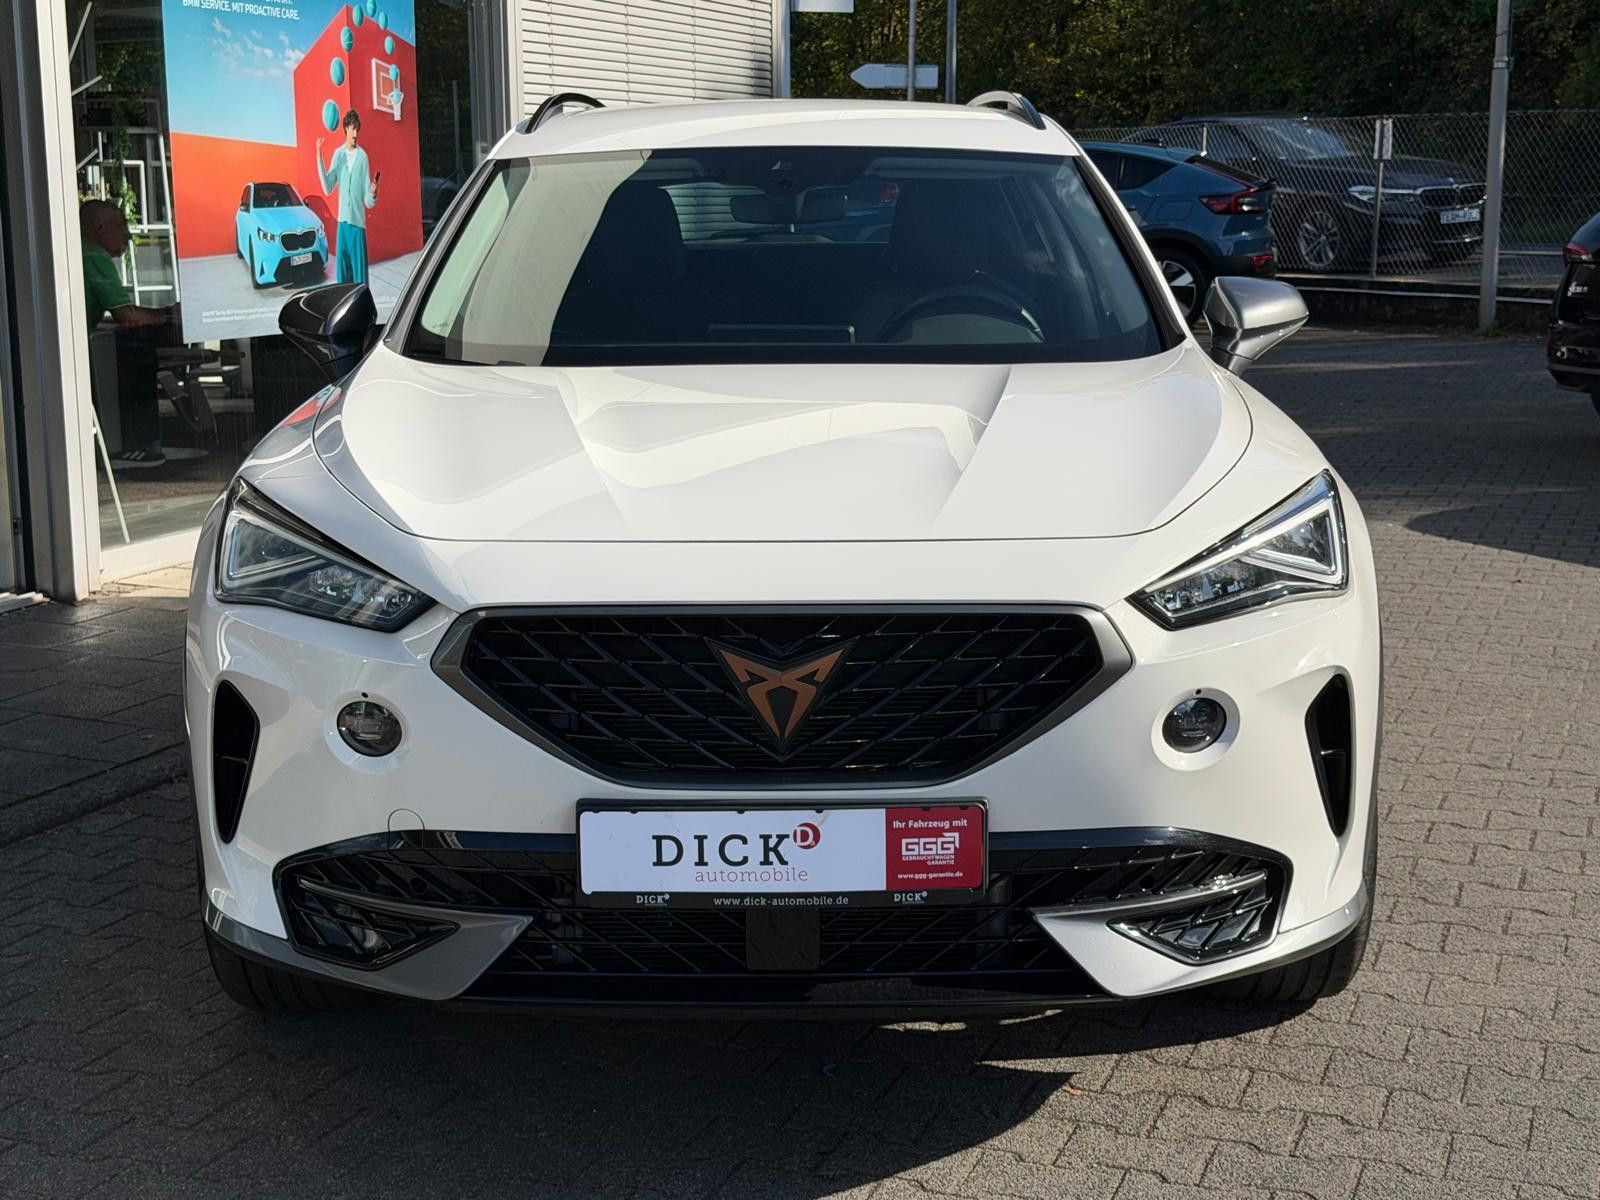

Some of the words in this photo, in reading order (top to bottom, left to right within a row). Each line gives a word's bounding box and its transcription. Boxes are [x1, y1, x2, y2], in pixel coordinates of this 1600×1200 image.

[201, 0, 231, 12] SERVICE.
[232, 3, 245, 13] MIT
[245, 5, 281, 18] PROACTIVE
[893, 821, 906, 829] Ihr
[908, 819, 950, 829] Fahrzeug
[952, 818, 968, 827] mit
[652, 834, 790, 867] DICK
[902, 838, 955, 855] GGG
[695, 867, 808, 883] automobile
[897, 871, 963, 880] www.ggg-garantie.de
[636, 895, 665, 904] DICK
[713, 895, 849, 906] www.dick-automobile.de
[894, 893, 921, 902] DICK
